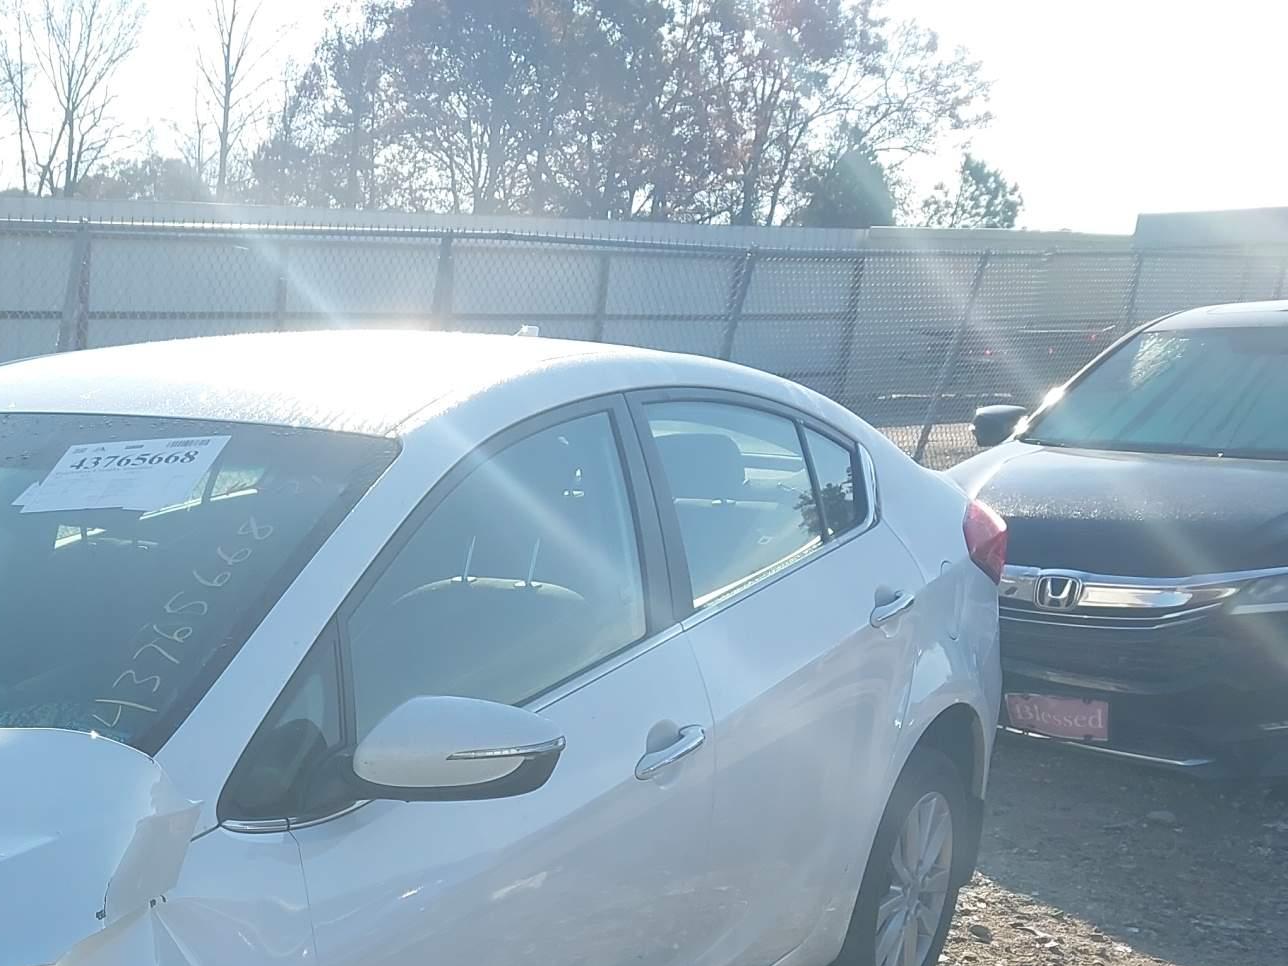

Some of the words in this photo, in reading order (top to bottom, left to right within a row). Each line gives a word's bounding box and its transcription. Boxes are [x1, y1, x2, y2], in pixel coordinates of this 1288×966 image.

[70, 450, 199, 470] 43765668
[91, 515, 274, 728] 43765668
[1015, 703, 1104, 729] Blessed
